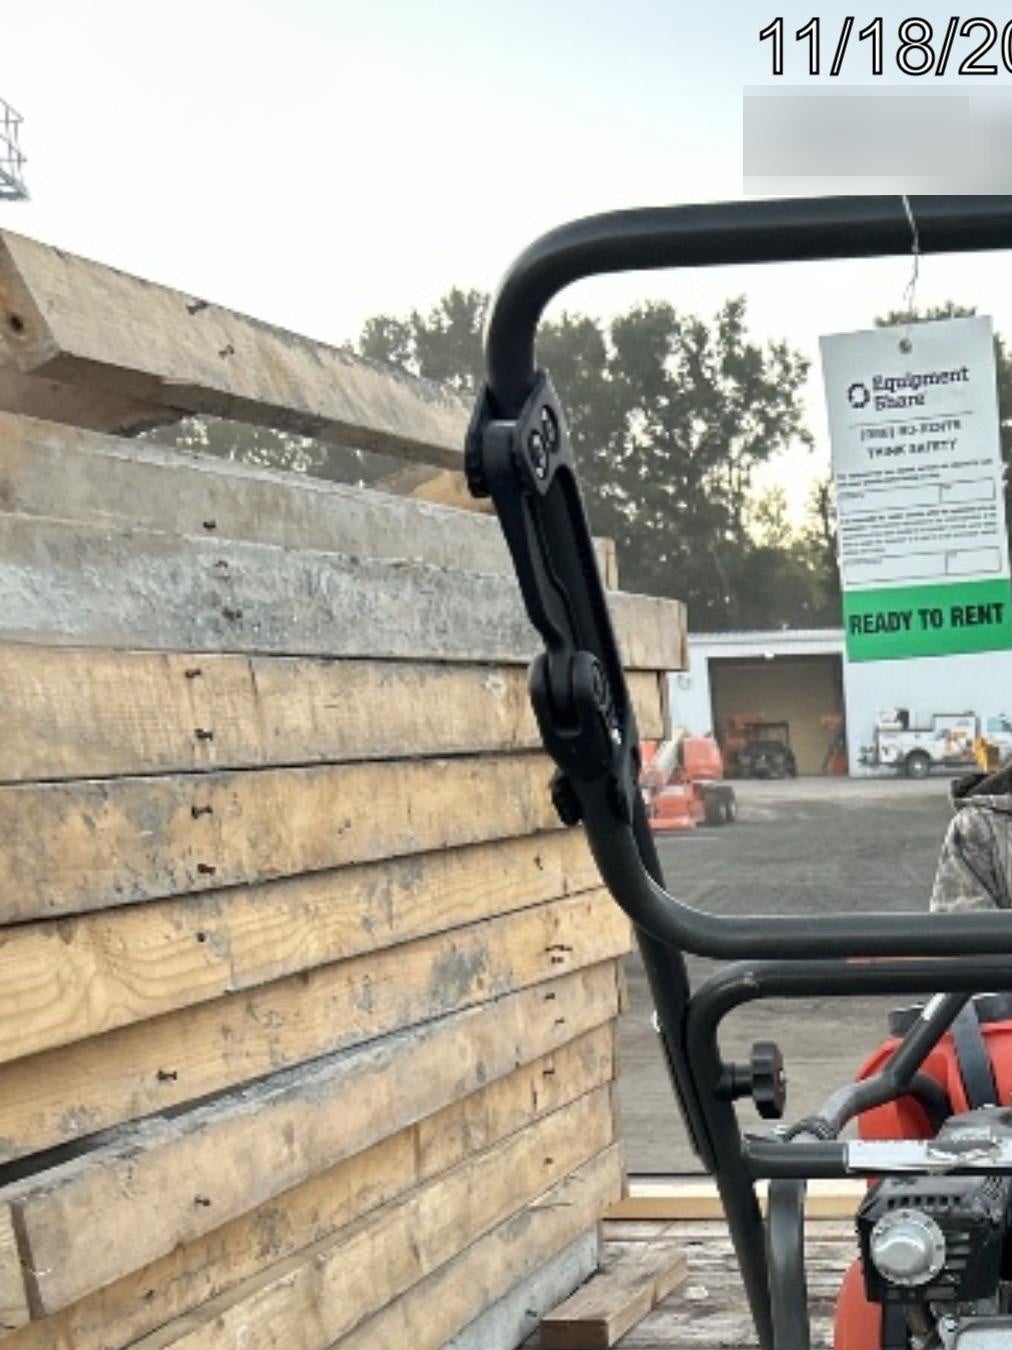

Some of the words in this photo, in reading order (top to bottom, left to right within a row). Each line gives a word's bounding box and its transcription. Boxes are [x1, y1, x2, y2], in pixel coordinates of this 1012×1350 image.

[872, 366, 970, 393] Equipment
[848, 608, 913, 636] READY
[917, 607, 943, 630] TO
[950, 602, 1004, 628] RENT
